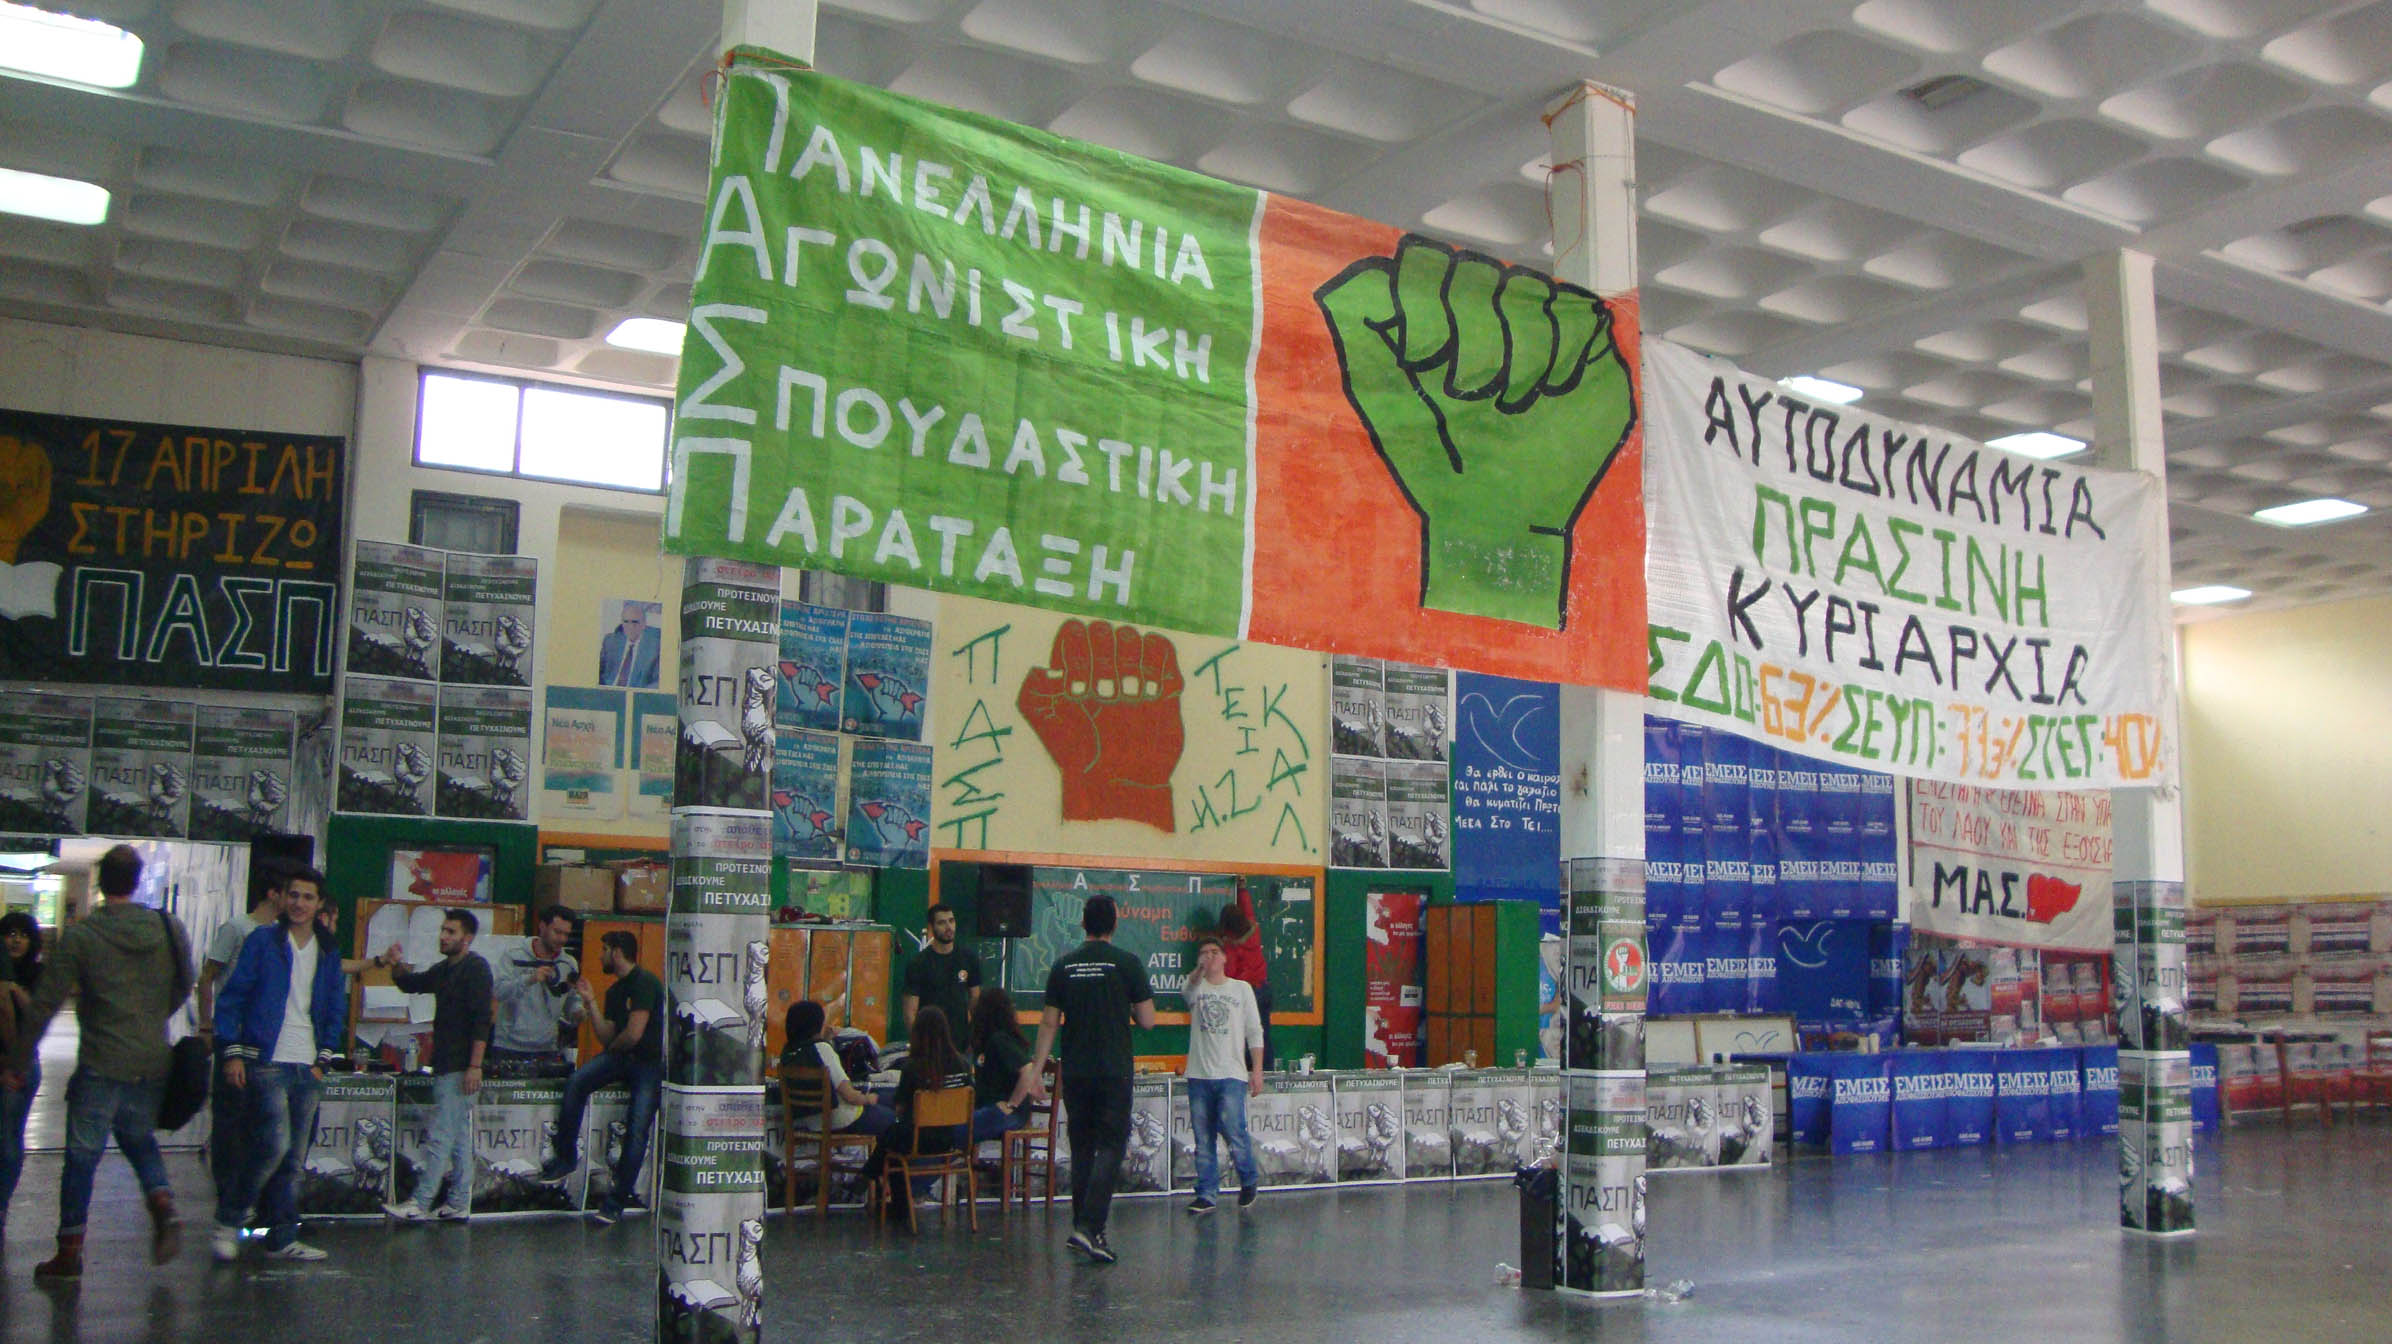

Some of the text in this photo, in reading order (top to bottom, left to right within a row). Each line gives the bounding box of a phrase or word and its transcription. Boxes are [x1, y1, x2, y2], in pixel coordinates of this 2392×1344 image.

[713, 69, 1214, 290] ΠΑΝΕΛΛΗΝΙΑ
[698, 176, 1212, 383] ΑΓΩΝΙΣΤΙΚΗ
[679, 303, 1237, 516] ΣΠΟΥΔΑΣΤΙΚΗ
[76, 429, 335, 501] 17 ΑΠΡΙΛΗ
[1704, 376, 2106, 541] ΑΥΤΟΔΥΝΑΜΙΑ
[667, 437, 1134, 606] ΠΑΡΑΤΑΞΗ
[67, 503, 317, 570] ΣΤΗΡΙΖΩ
[1754, 483, 2049, 627] ΠΡΑΣΙΝΗ
[69, 566, 336, 677] ΠΑΣΠ
[355, 608, 402, 626] ΠΑΣΠ
[446, 619, 493, 636] ΠΑΣΠ
[1727, 566, 2089, 707] ΚΥΡΙΑΡΧΙΑ
[1335, 701, 1366, 716] ΠΑΣΠ
[1387, 707, 1420, 721] ΠΑΣΠ
[344, 745, 393, 765] ΠΑΣΠ
[441, 752, 488, 770] ΠΑΣΠ
[95, 766, 145, 785] ΠΑΣΠ
[1705, 762, 1748, 779] ΕΜΕΙΣ
[1821, 773, 1860, 787] ΕΜΕΙΣ
[1335, 813, 1366, 827] ΠΑΣΠ
[1391, 816, 1422, 830] ΠΑΣΠ
[1706, 860, 1750, 875] ΕΜΕΙΣ
[1780, 860, 1818, 875] ΕΜΕΙΣ
[1820, 861, 1860, 875] ΕΜΕΙΣ
[670, 952, 738, 984] ΠΑΣΠ
[1706, 958, 1747, 973] ΕΜΕΙΣ
[1834, 1077, 1890, 1096] ΕΜΕΙΣ
[1894, 1074, 1945, 1092] ΕΜΕΙΣ
[1944, 1073, 1994, 1090] ΕΜΕΙΣ
[1998, 1072, 2049, 1089] ΕΜΕΙΣ
[1405, 1108, 1445, 1126] ΠΑΣΠ
[1455, 1106, 1494, 1124] ΠΑΣΠ
[1648, 1104, 1684, 1121] ΠΑΣΠ
[1251, 1114, 1295, 1132] ΠΑΣΠ
[478, 1129, 536, 1149] ΠΑΣΠ
[1570, 1184, 1629, 1212] ΠΑΣΠ
[661, 1228, 732, 1264] ΠΑΣΠ
